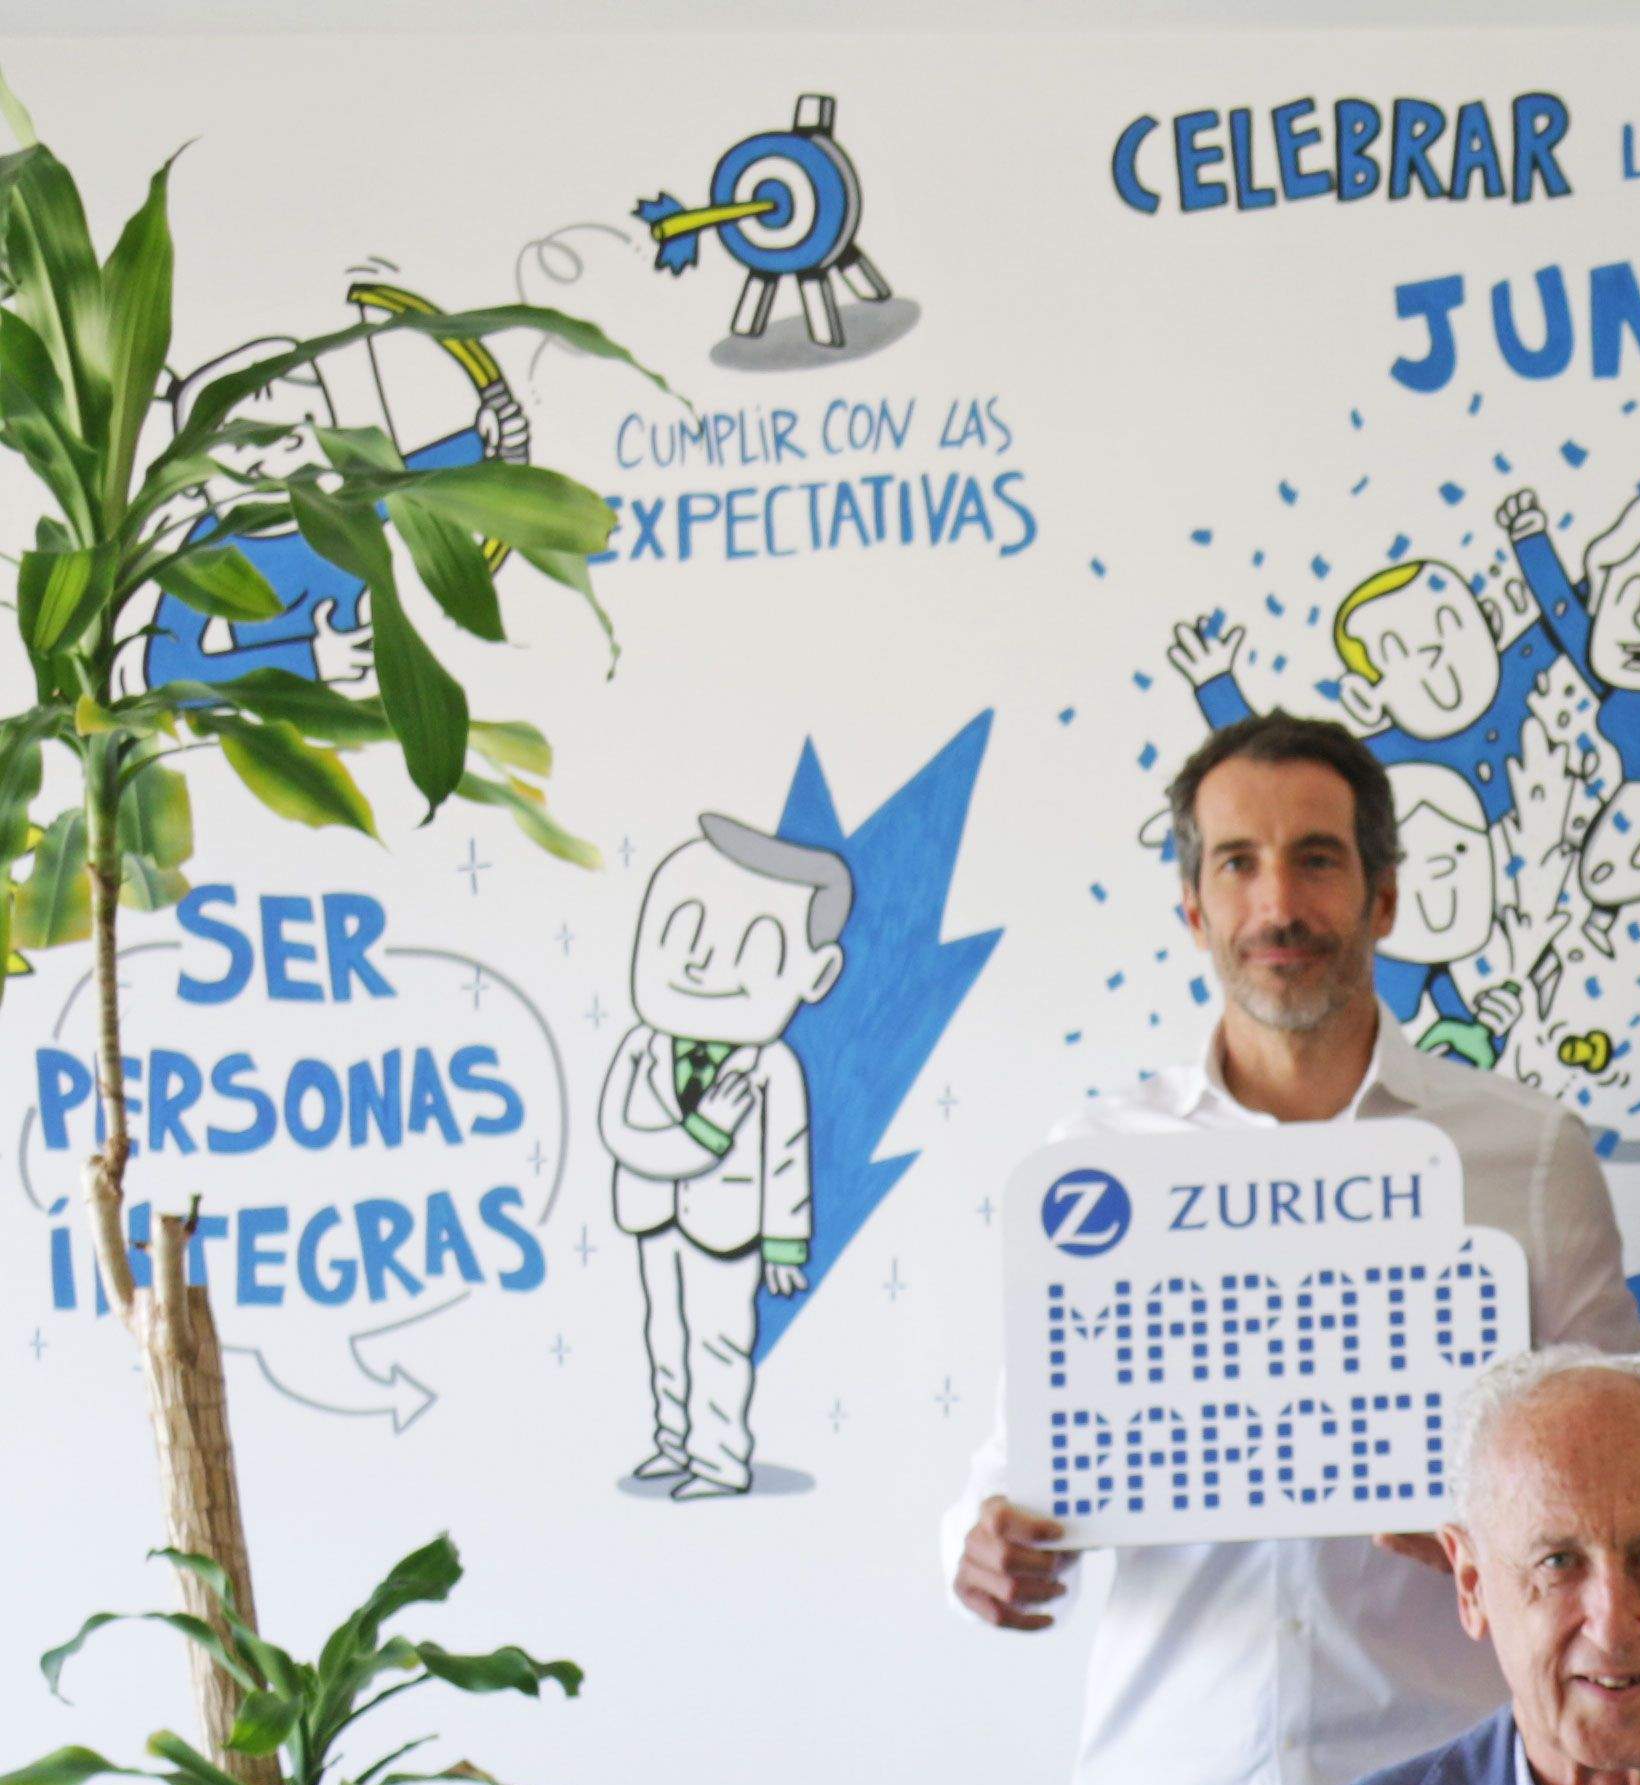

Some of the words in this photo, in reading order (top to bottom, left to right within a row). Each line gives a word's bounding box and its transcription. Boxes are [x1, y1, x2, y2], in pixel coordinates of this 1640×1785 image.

[1112, 91, 1572, 214] CELEBRAR
[821, 396, 916, 455] CON
[939, 394, 1012, 456] LAS
[176, 884, 397, 1006] SER
[1169, 1173, 1422, 1232] ZURICH
[1047, 1236, 1497, 1388] MARATÓ
